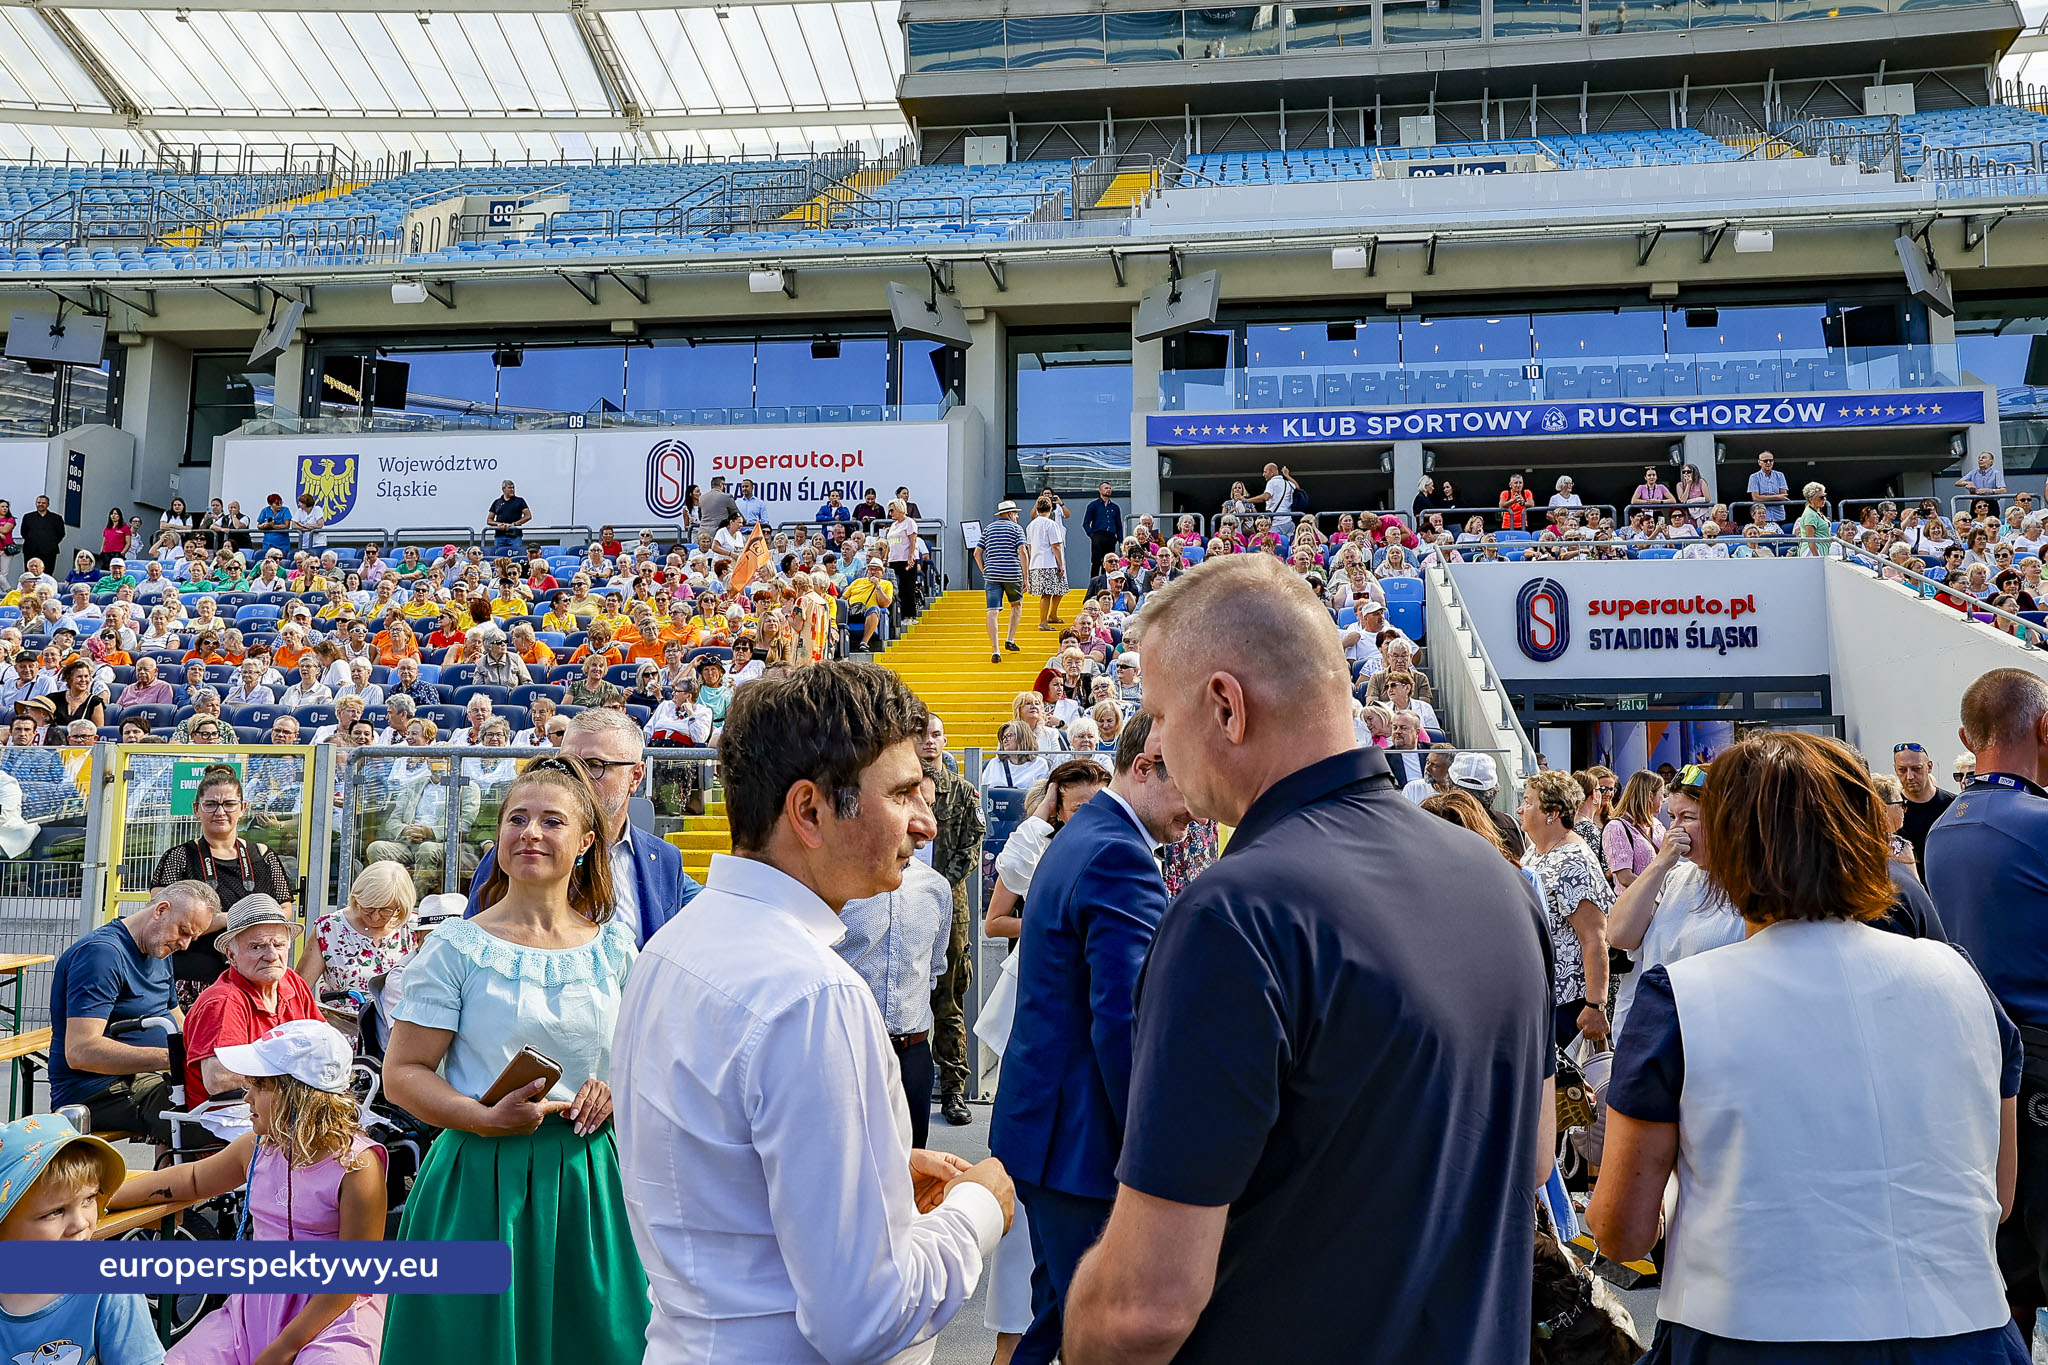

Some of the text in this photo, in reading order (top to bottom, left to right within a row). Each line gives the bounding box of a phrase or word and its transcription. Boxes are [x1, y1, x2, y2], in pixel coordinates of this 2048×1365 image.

[493, 204, 514, 223] 08
[1525, 365, 1540, 379] 10
[568, 414, 584, 428] 09
[1283, 417, 1357, 437] KLUB
[1367, 410, 1533, 435] SPORTOWY
[1578, 407, 1659, 428] RUCH
[1669, 398, 1826, 426] CHORZÓW
[378, 454, 498, 477] Województwo
[712, 449, 864, 475] superauto.pl
[376, 478, 438, 502] Śląskie
[1588, 594, 1756, 621] superauto.pl
[1589, 620, 1758, 656] STADION ŚLĄSKI
